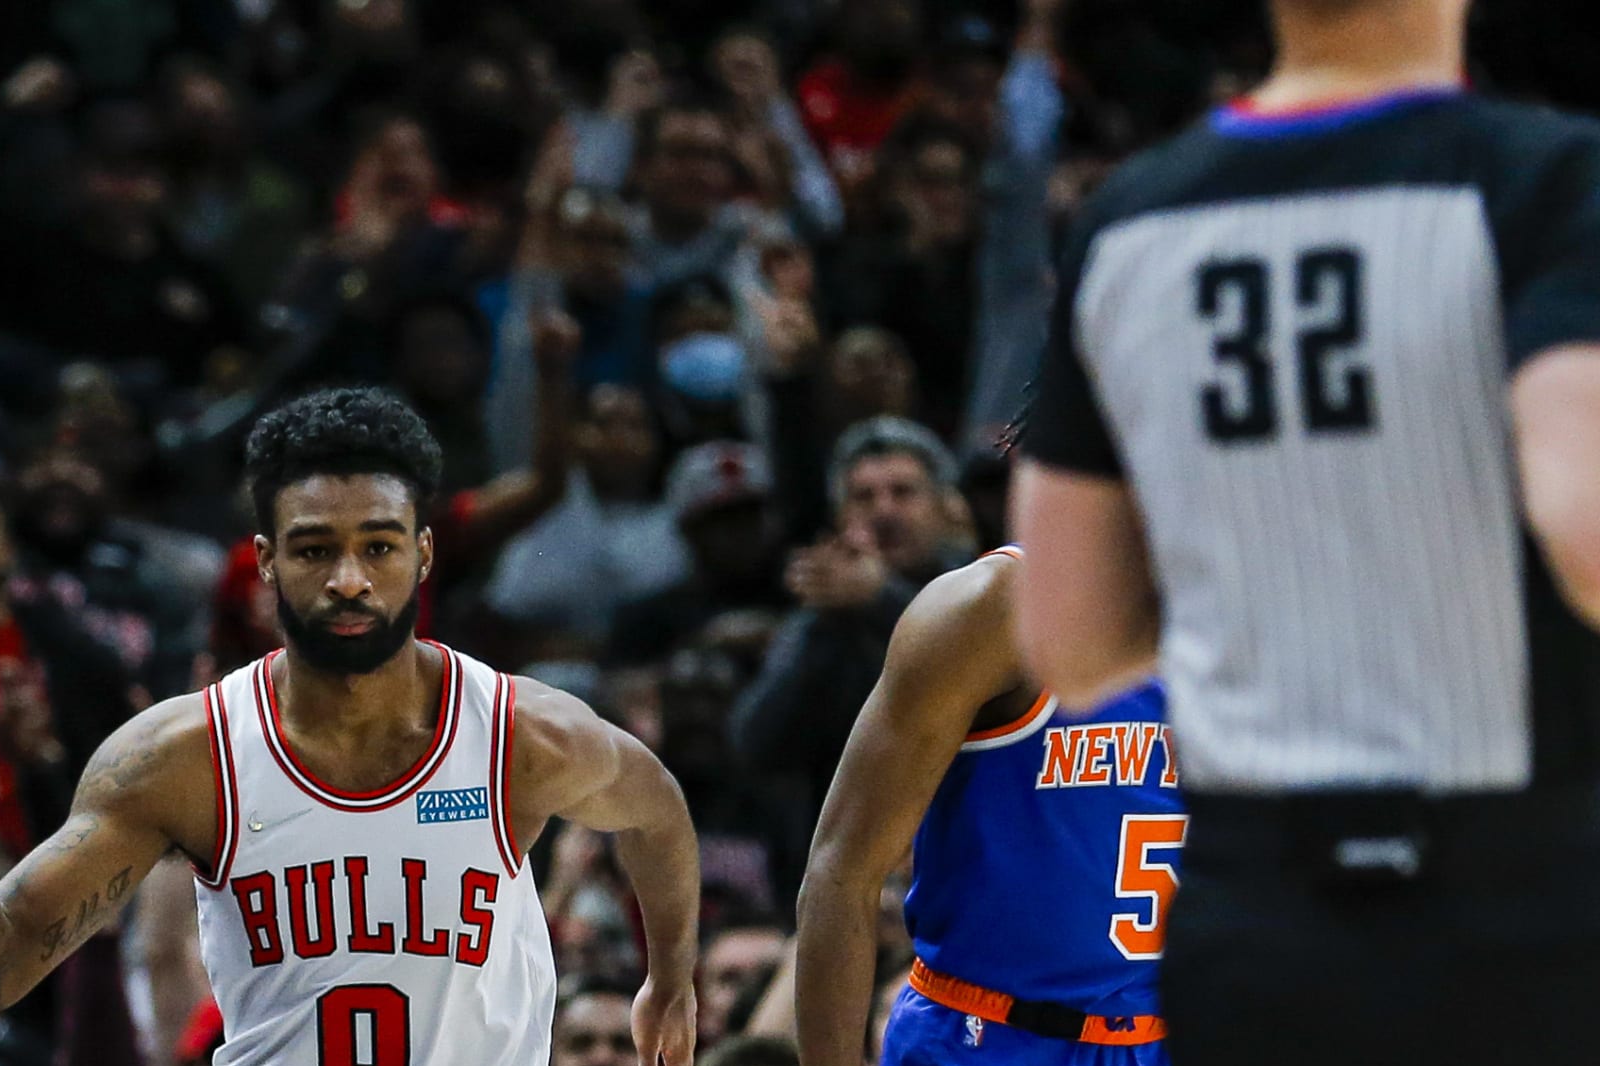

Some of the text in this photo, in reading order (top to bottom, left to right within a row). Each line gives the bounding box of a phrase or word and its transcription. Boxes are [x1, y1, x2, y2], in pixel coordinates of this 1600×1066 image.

[1196, 244, 1376, 442] 32
[419, 790, 485, 809] ZENNI
[1035, 721, 1159, 790] NEW
[420, 808, 486, 821] EYEWEAR
[231, 856, 499, 967] BULLS
[1109, 814, 1190, 960] 5
